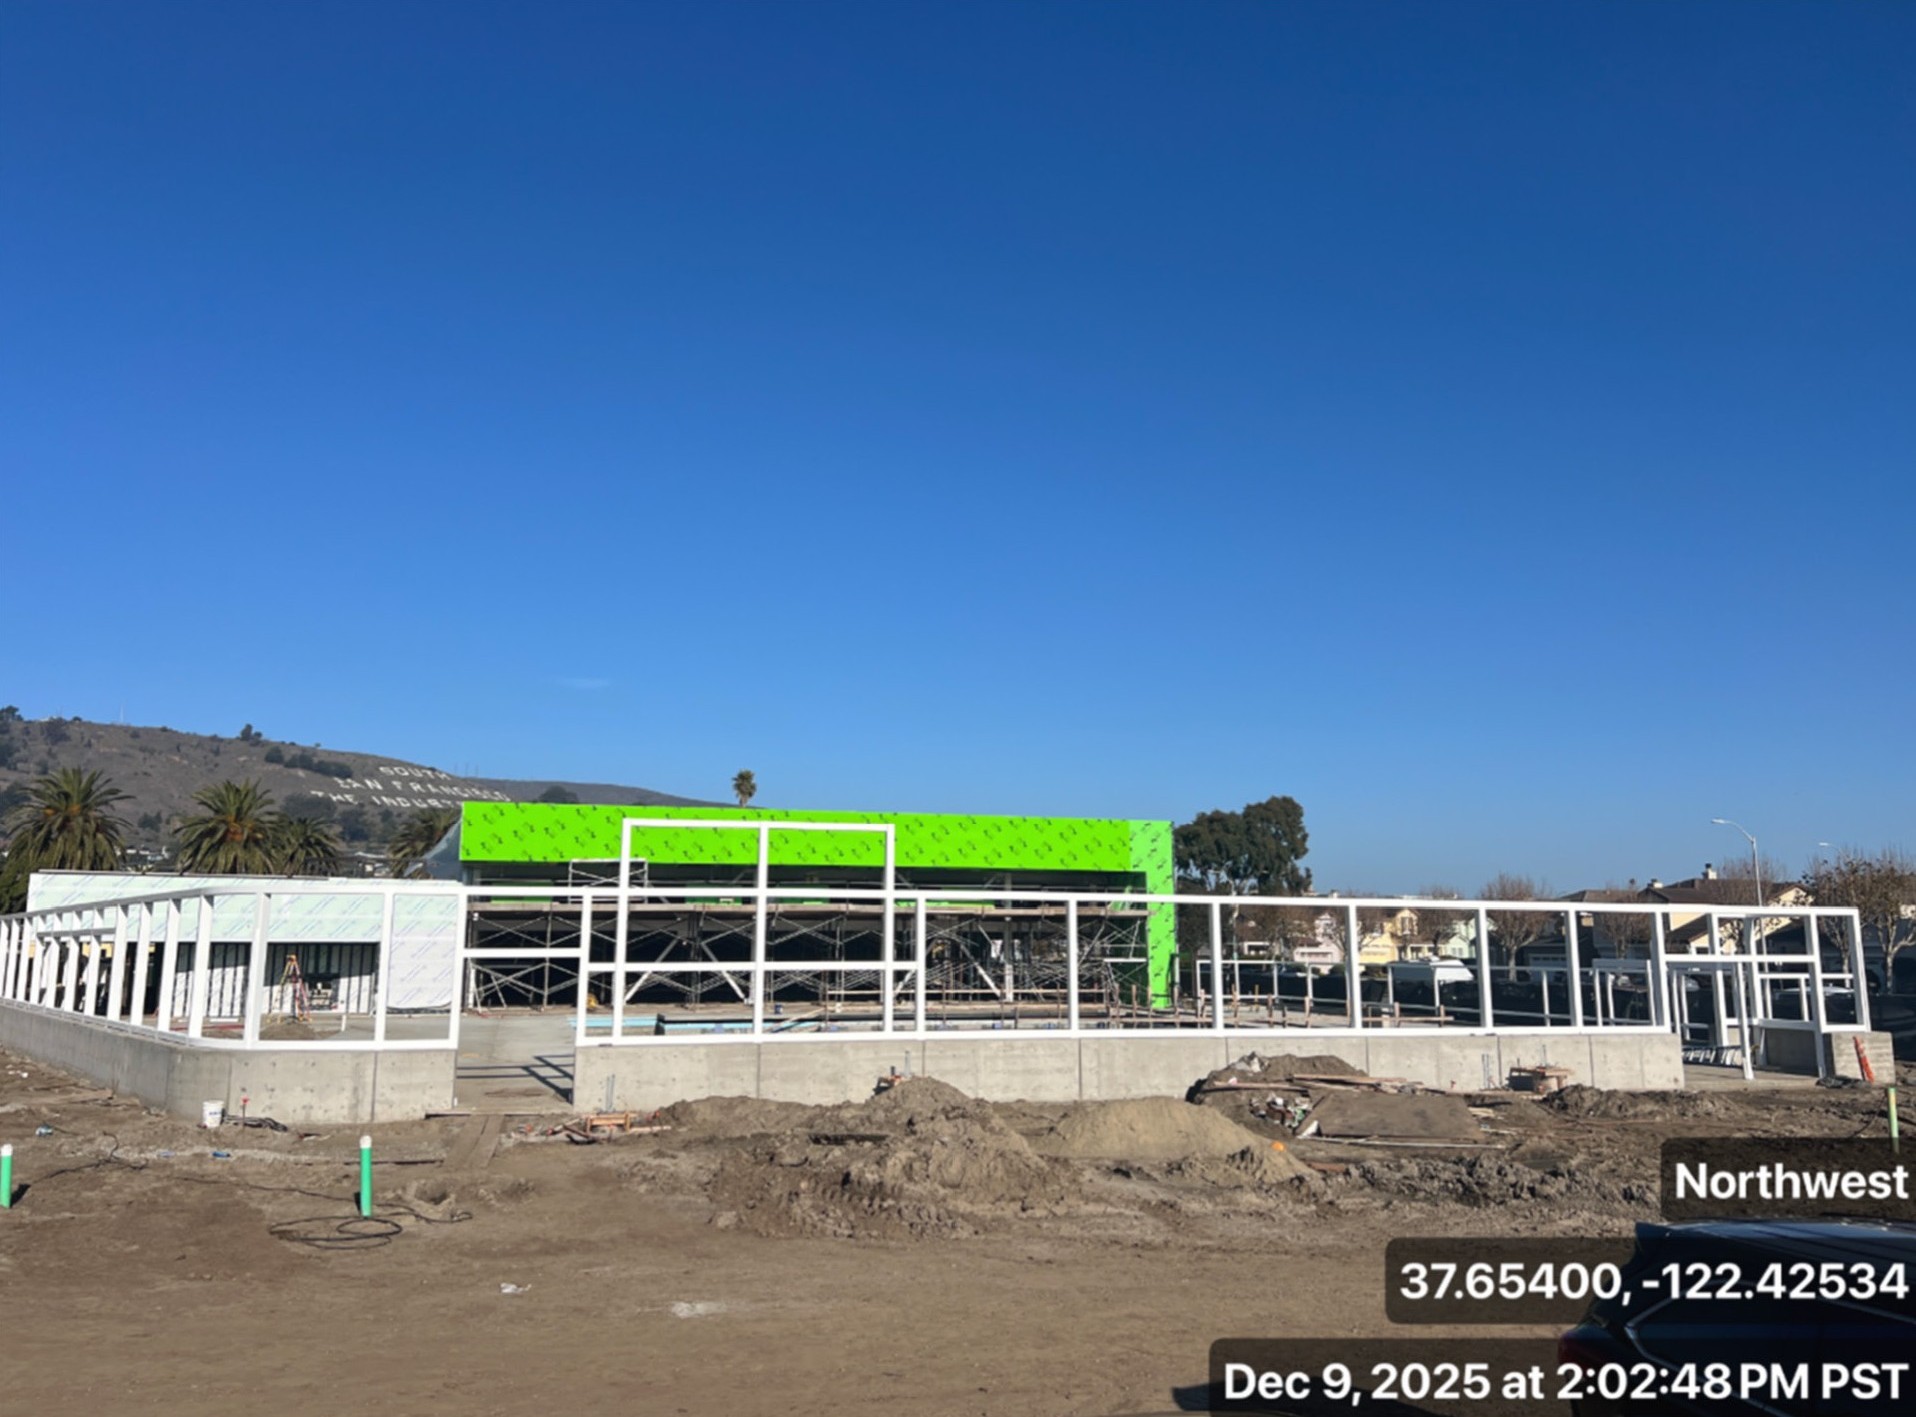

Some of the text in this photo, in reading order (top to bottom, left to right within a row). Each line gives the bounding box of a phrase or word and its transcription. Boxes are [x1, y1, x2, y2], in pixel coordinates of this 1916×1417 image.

[379, 766, 452, 780] SOUTH
[333, 777, 511, 802] SAN FRANCISCO
[310, 790, 358, 805] THE
